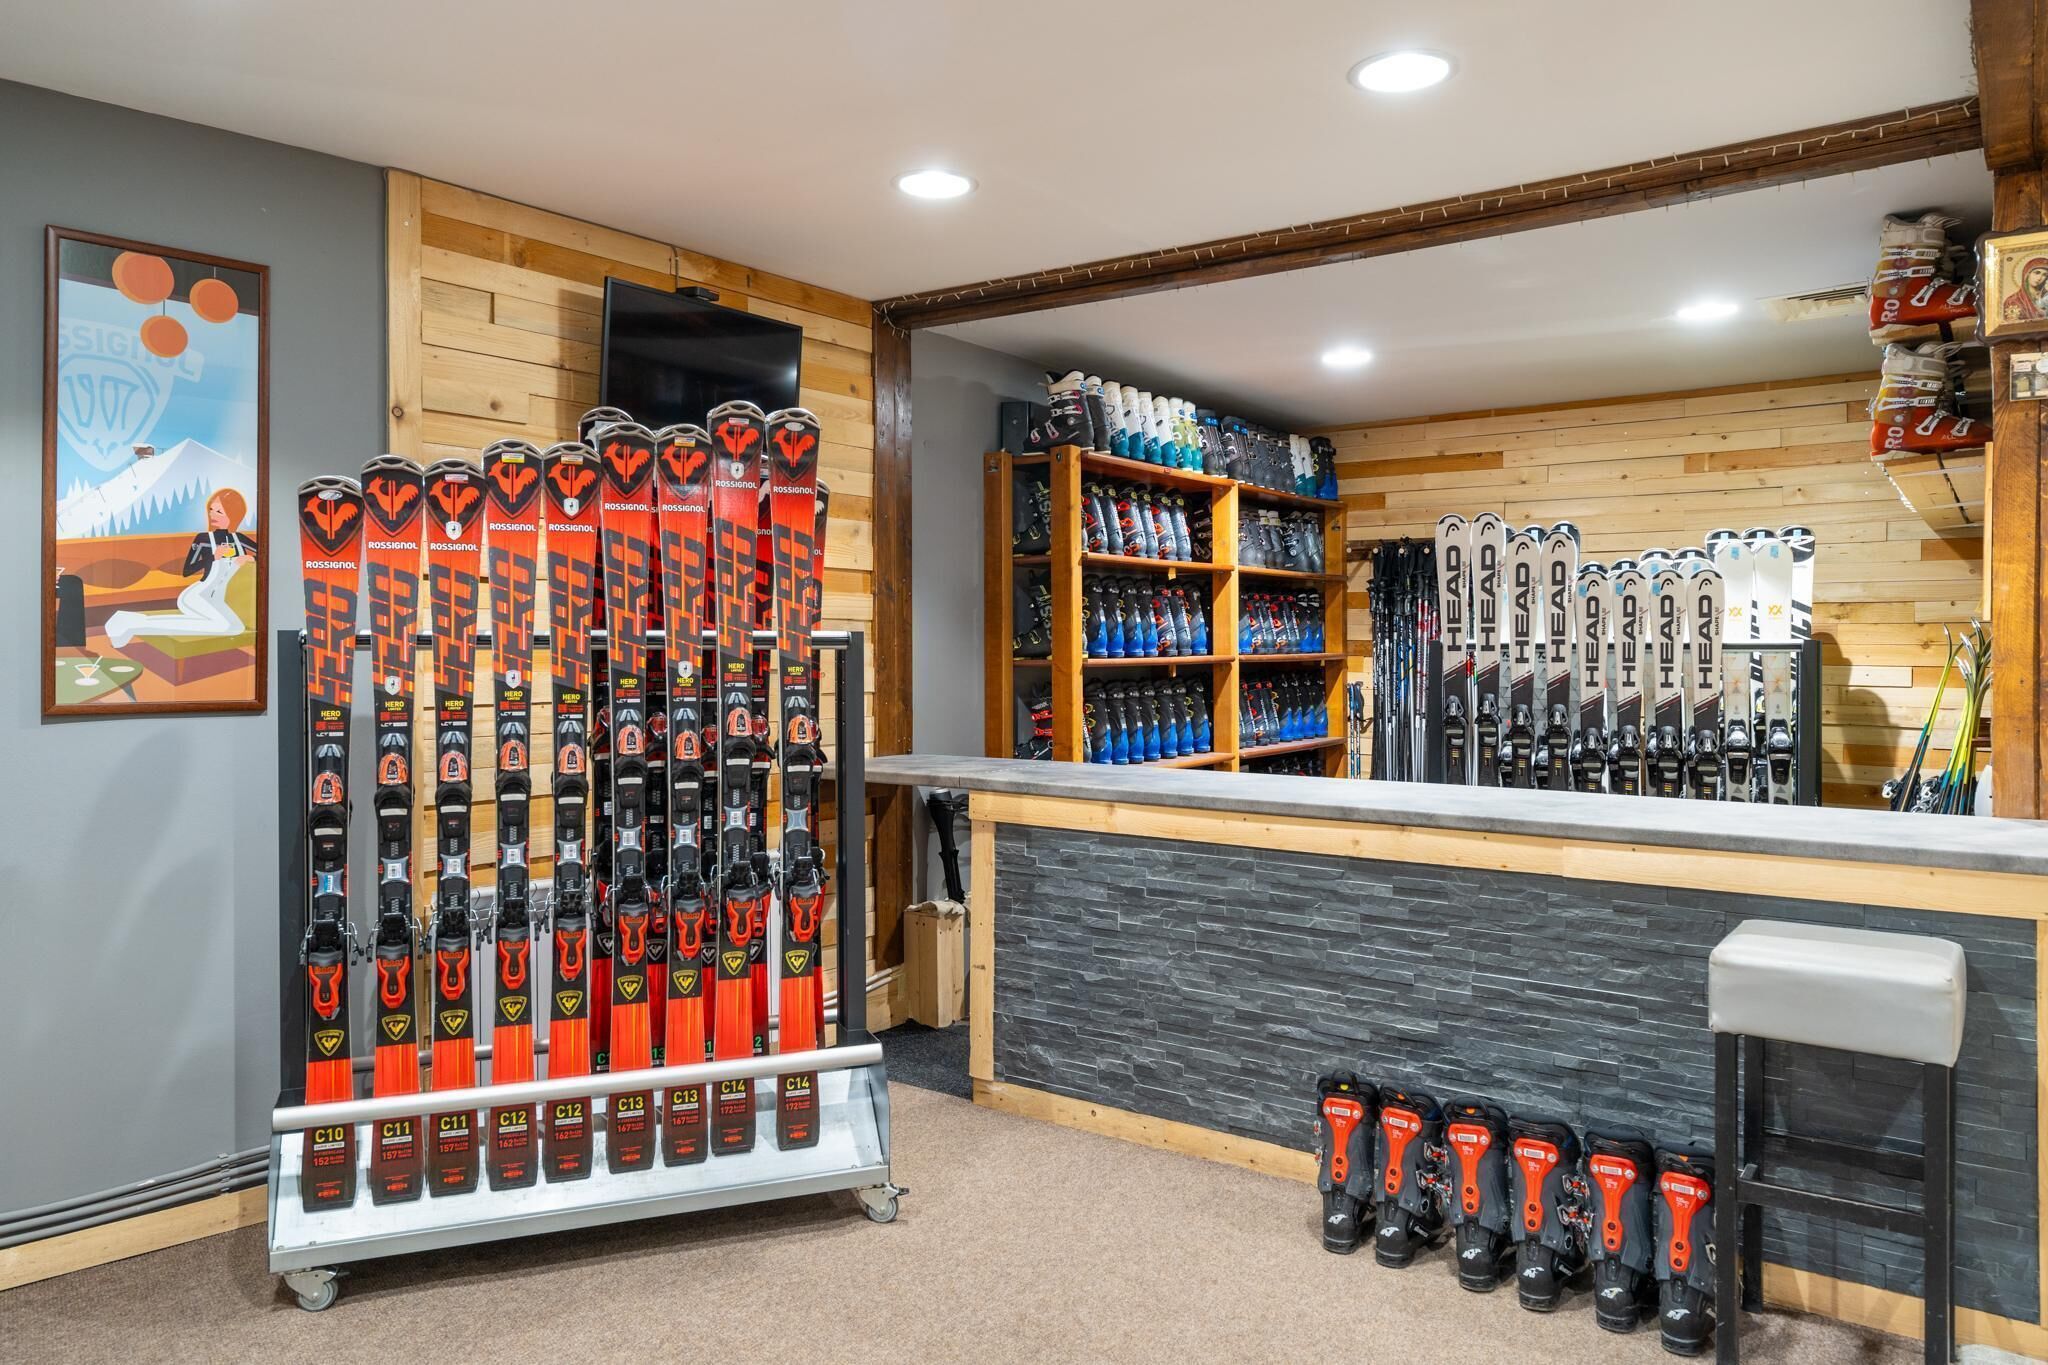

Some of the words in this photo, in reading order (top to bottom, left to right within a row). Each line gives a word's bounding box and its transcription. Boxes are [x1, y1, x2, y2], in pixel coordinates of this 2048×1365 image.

[716, 480, 757, 488] ROSSIGNOL
[774, 486, 814, 494] ROSSIGNOL
[605, 503, 649, 511] ROSSIGNOL
[490, 523, 536, 531] ROSSIGNOL
[549, 524, 594, 532] ROSSIGNOL
[430, 543, 479, 551] ROSSIGNOL
[306, 561, 357, 569] ROSSIGNOL
[1447, 545, 1461, 651] HEAD
[1481, 544, 1495, 651] HEAD
[1515, 563, 1529, 663] HEAD
[1551, 561, 1565, 663] HEAD
[1586, 596, 1599, 687] HEAD
[1622, 595, 1636, 687] HEAD
[1660, 595, 1673, 688] HEAD
[1699, 595, 1712, 688] HEAD
[722, 1080, 745, 1093] C14
[786, 1076, 809, 1089] C14
[674, 1090, 697, 1103] C13
[618, 1097, 644, 1110] C13
[721, 1106, 733, 1114] 172
[785, 1102, 798, 1110] 172
[556, 1104, 581, 1117] C12
[441, 1115, 466, 1130] C11
[501, 1111, 526, 1125] C12
[673, 1117, 686, 1125] 167
[383, 1122, 410, 1136] C11
[618, 1124, 630, 1132] 167
[316, 1128, 343, 1142] C10
[555, 1132, 568, 1140] 162
[440, 1144, 454, 1152] 157
[499, 1140, 513, 1148] 162
[314, 1157, 329, 1166] 152
[382, 1151, 397, 1160] 157
